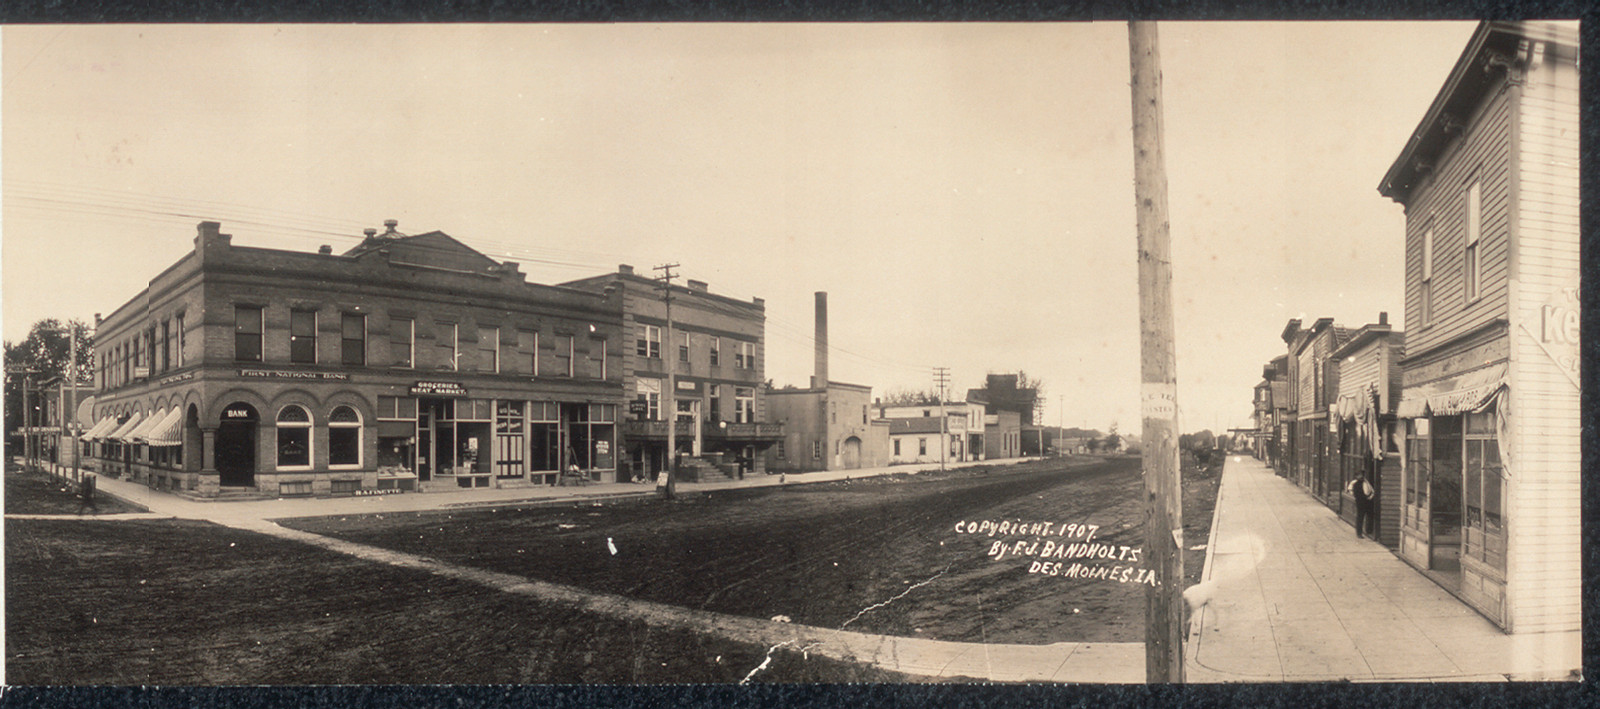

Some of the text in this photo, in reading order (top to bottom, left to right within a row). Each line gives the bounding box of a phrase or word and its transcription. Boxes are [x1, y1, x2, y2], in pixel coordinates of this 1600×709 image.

[241, 369, 348, 380] FIRST NATIONAL BANK
[228, 410, 248, 418] BANK
